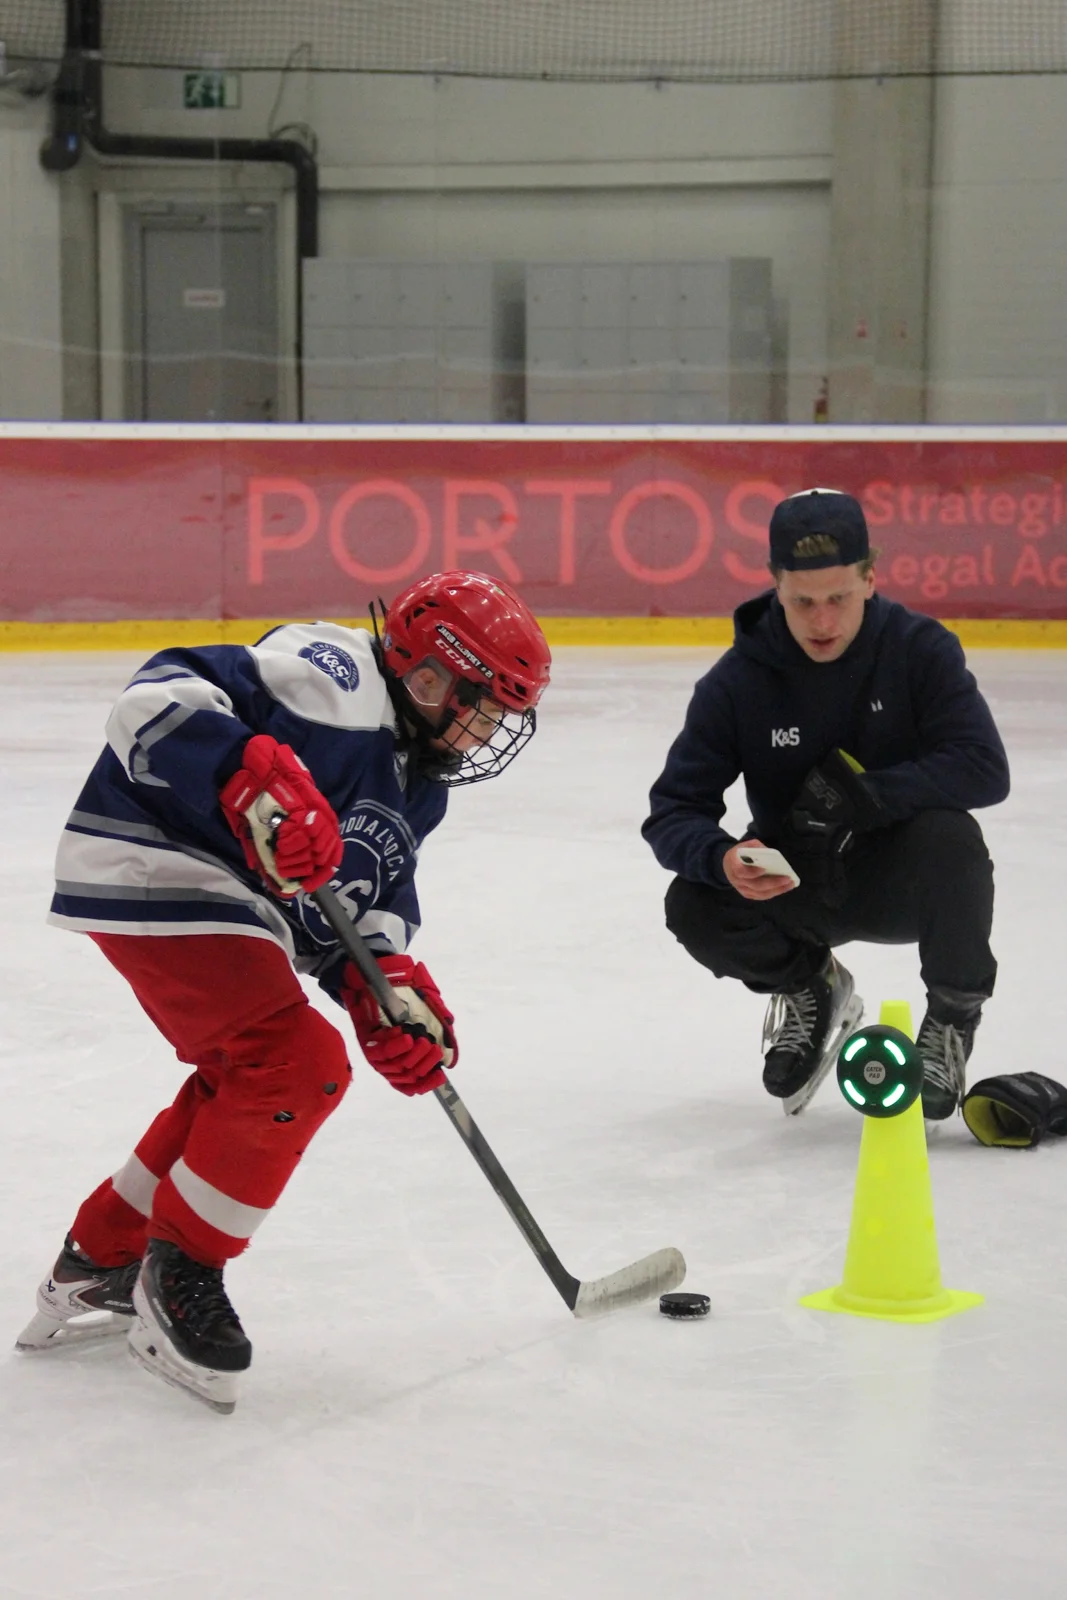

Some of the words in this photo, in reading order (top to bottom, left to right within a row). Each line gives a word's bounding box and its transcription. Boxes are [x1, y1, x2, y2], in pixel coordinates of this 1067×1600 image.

[248, 479, 785, 585] PORTOS
[314, 650, 350, 678] K&S
[435, 638, 472, 671] CCM
[771, 727, 800, 748] K&S
